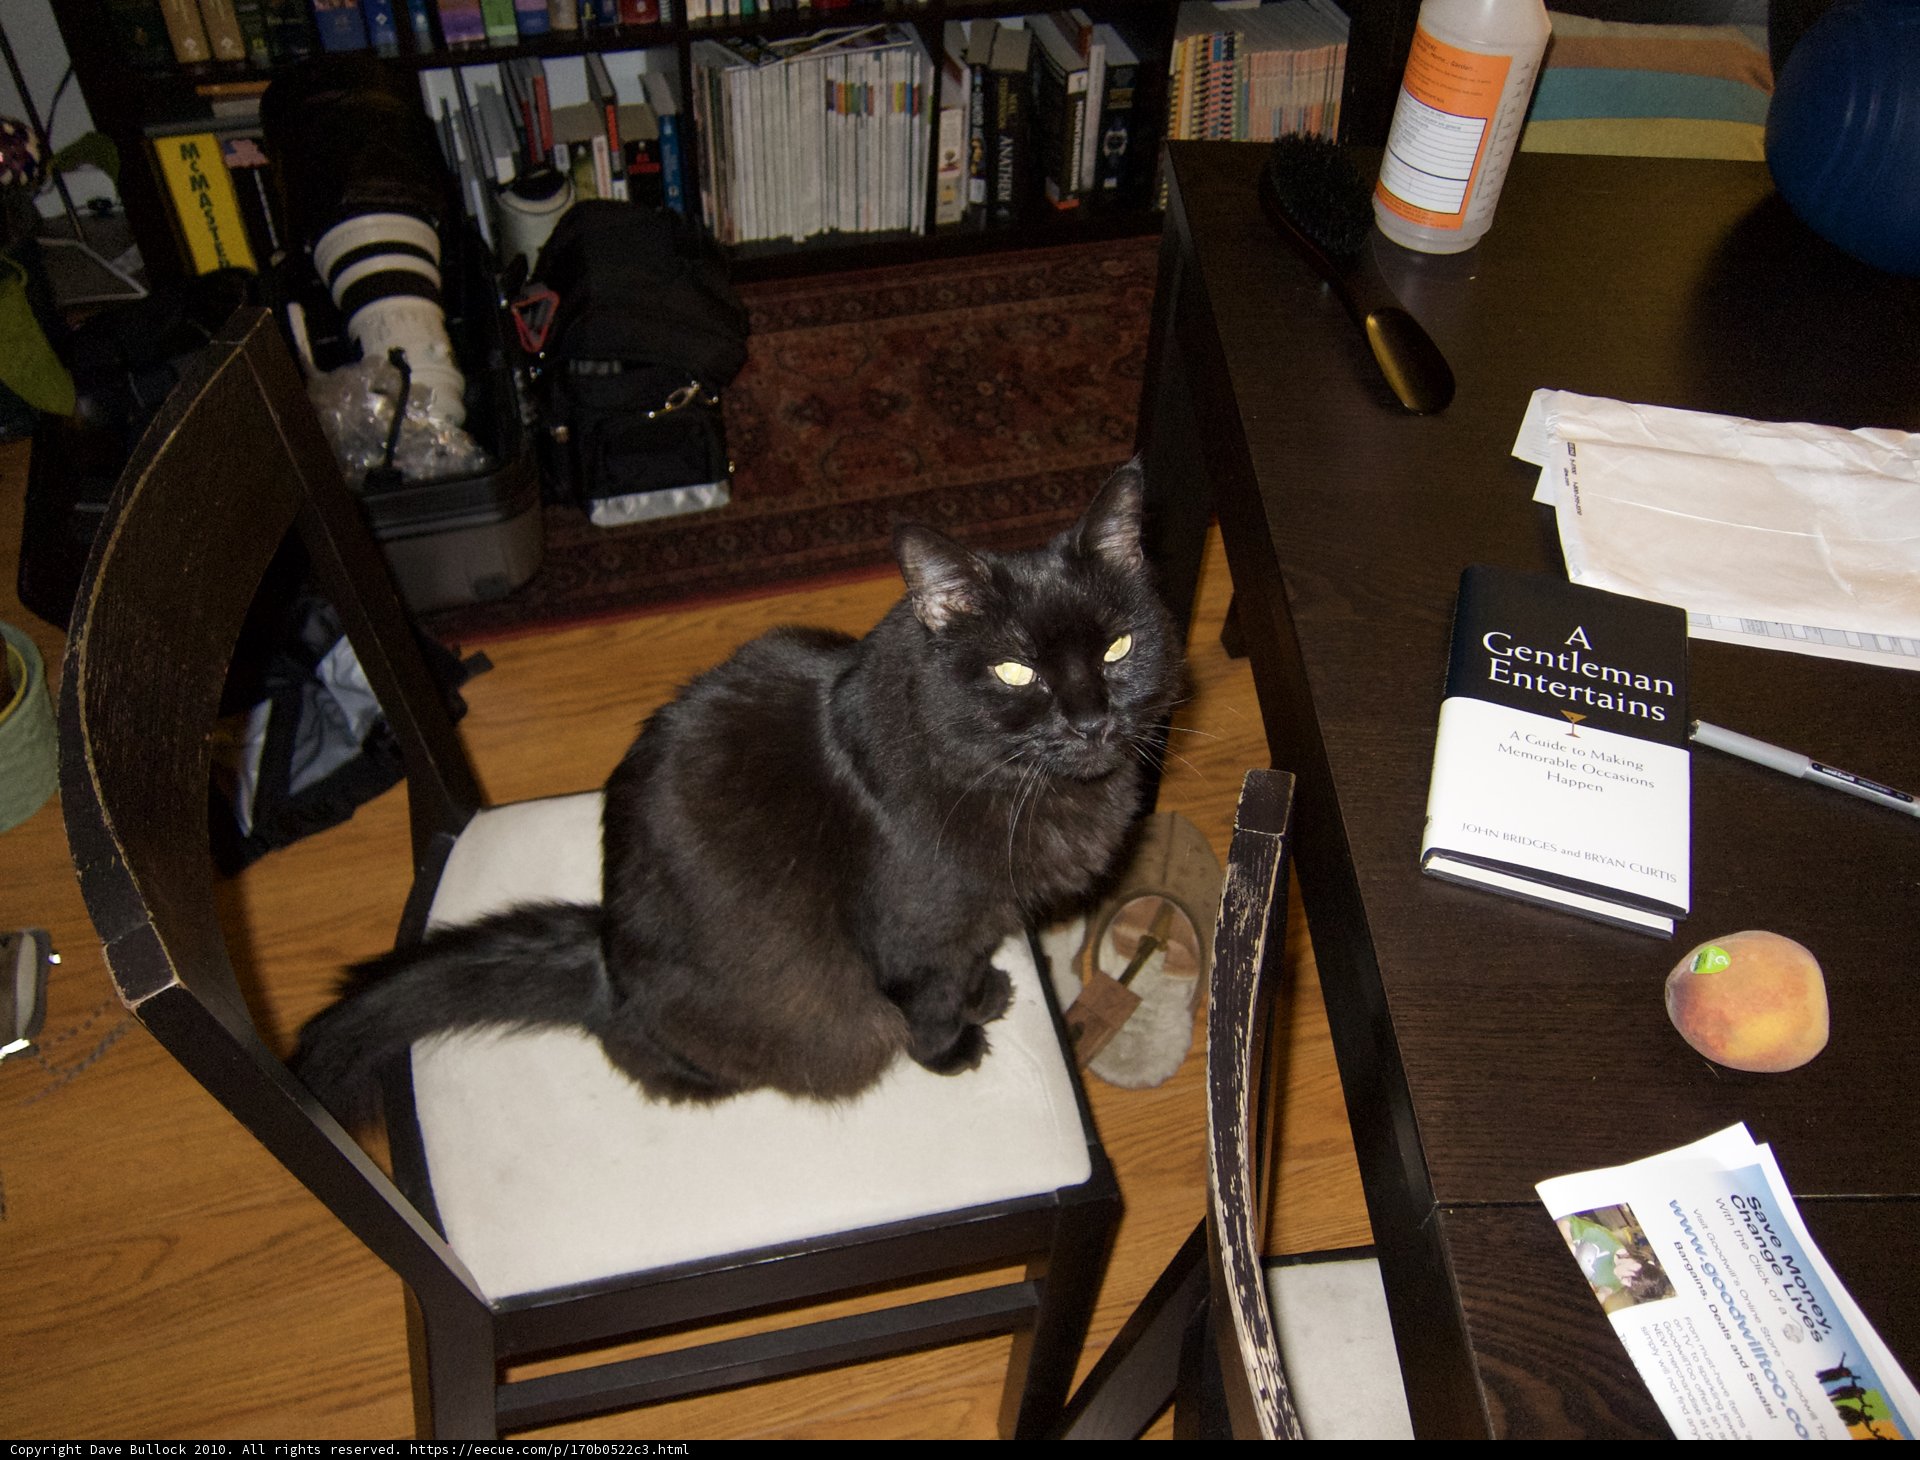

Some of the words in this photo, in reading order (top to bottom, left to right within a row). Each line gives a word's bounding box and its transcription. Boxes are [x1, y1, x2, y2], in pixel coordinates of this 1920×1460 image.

[997, 135, 1013, 201] ANATHEM
[1483, 632, 1673, 696] Gentleman
[1564, 625, 1592, 651] A
[1489, 658, 1665, 721] Entertains
[1498, 744, 1577, 770] Memorable
[1582, 764, 1654, 788] Occasions
[1510, 731, 1520, 741] A
[1526, 734, 1567, 752] Guide
[1572, 748, 1585, 756] to
[1591, 750, 1643, 771] Making
[1548, 771, 1603, 792] Happen
[1463, 823, 1499, 838] JOHN
[1503, 833, 1557, 852] BRIDGES
[1561, 849, 1580, 858] and
[1585, 852, 1625, 868] BRYAN
[1629, 863, 1676, 883] CURTIS
[1693, 1208, 1708, 1229] Visit
[1706, 1232, 1740, 1286] Goodwill's
[1739, 1289, 1761, 1323] Online
[1760, 1326, 1781, 1357] Store
[1716, 1198, 1735, 1225] With
[1734, 1230, 1749, 1250] the
[1749, 1254, 1769, 1285] Click
[1769, 1289, 1782, 1302] of
[1778, 1307, 1787, 1315] a
[1731, 1195, 1783, 1276] Change
[1783, 1284, 1823, 1342] Lives
[1746, 1196, 1782, 1248] Save
[1781, 1255, 1832, 1334] Money,
[1641, 1326, 1660, 1356] simply
[1667, 1377, 1679, 1394] not
[1652, 1323, 1669, 1347] NEW
[1666, 1350, 1702, 1415] merchandise
[1700, 1419, 1709, 1429] at
[1673, 1319, 1683, 1332] on
[1691, 1352, 1699, 1362] to
[1697, 1365, 1724, 1411] sparkling
[1684, 1317, 1700, 1342] From
[1699, 1344, 1730, 1397] must-have
[1728, 1400, 1746, 1428] items
[1709, 1304, 1731, 1340] Deals
[1730, 1344, 1750, 1368] and
[1747, 1373, 1778, 1419] Steals!
[1695, 1383, 1712, 1413] offers
